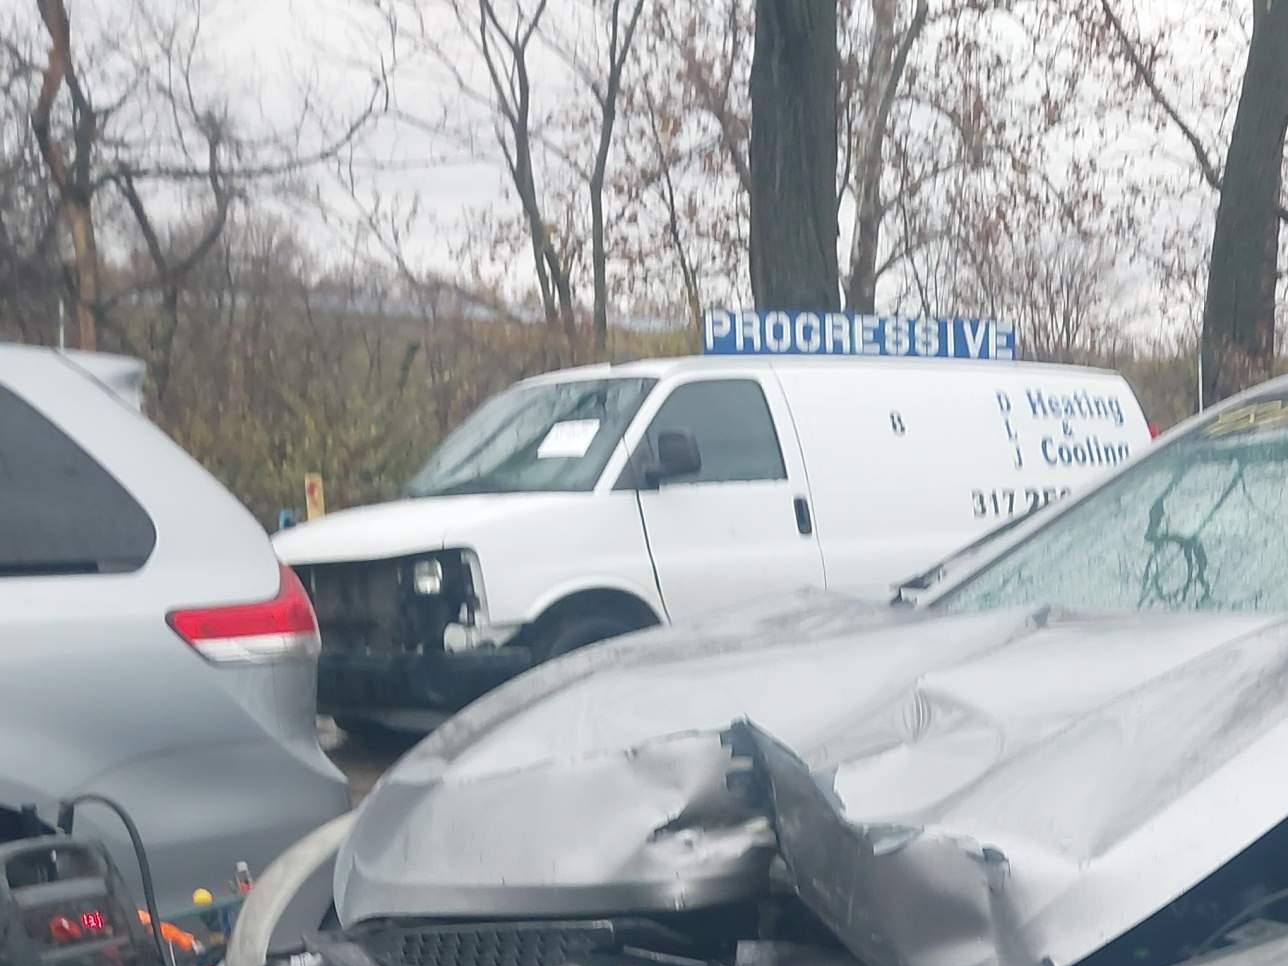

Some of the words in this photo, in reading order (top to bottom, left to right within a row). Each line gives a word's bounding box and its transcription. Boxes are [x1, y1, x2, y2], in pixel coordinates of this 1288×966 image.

[704, 310, 1014, 361] PROGRESSIVE
[1025, 388, 1125, 427] Heating
[971, 487, 1015, 518] 317
